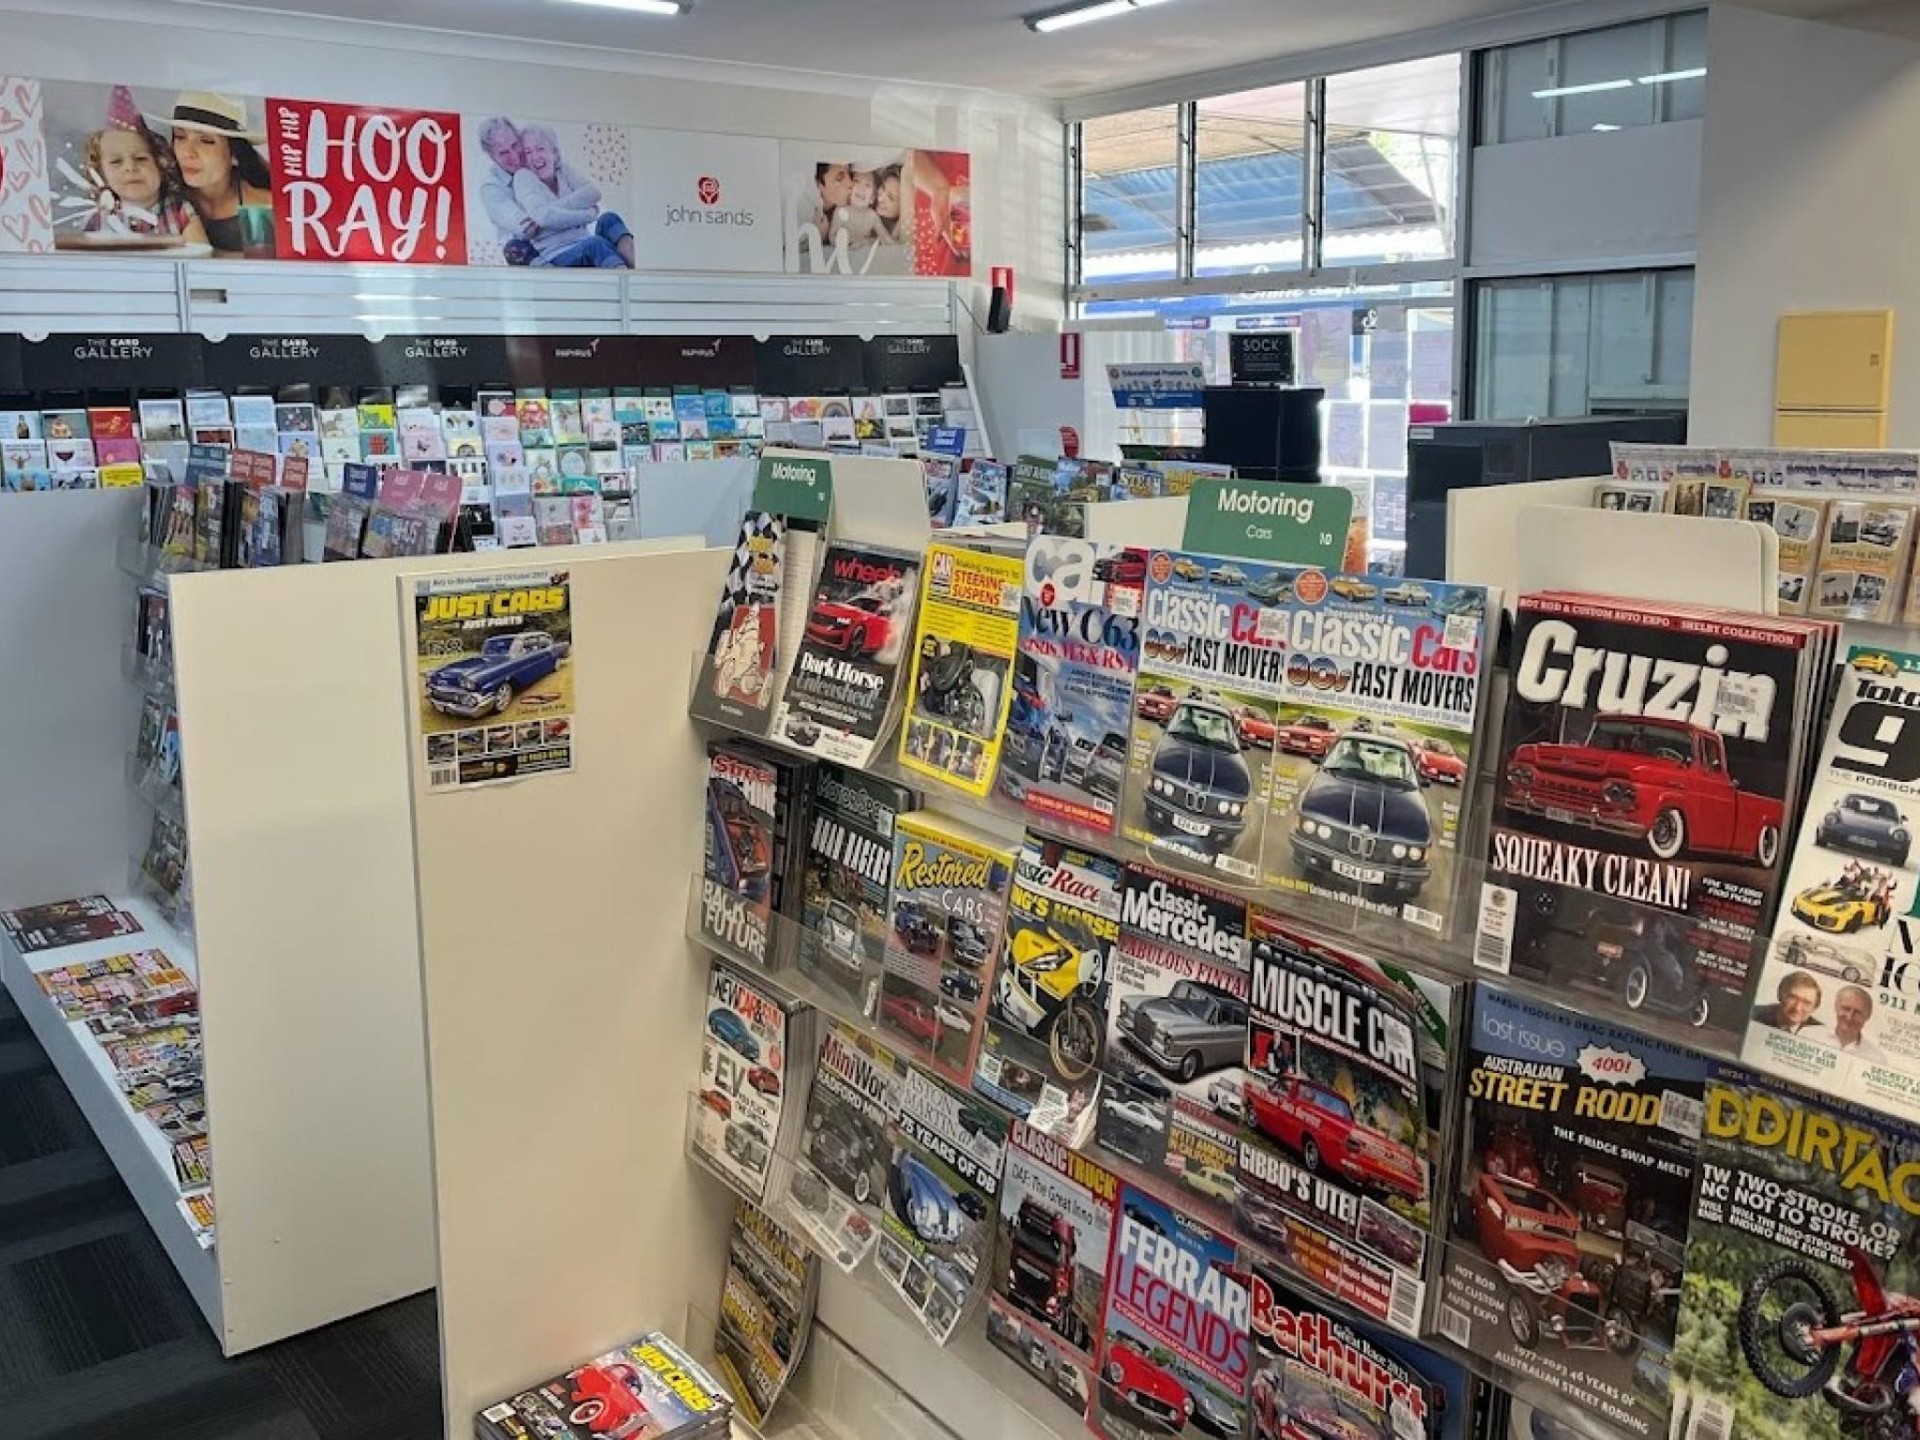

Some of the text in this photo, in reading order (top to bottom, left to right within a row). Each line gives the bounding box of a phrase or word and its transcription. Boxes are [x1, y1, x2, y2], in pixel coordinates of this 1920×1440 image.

[282, 106, 304, 177] HIP HIP
[305, 109, 453, 186] HOO
[283, 181, 453, 261] RAY!
[664, 205, 755, 227] john sands
[74, 346, 153, 359] GALLERY
[110, 338, 140, 347] CARD
[249, 346, 319, 359] GALLERY
[405, 346, 468, 358] GALLERY
[783, 345, 832, 357] GALLERY
[1242, 338, 1281, 352] SOCK
[771, 462, 817, 487] Motoring
[1217, 489, 1315, 524] Motoring
[1245, 524, 1274, 540] Cars
[1319, 532, 1333, 546] 10
[424, 586, 566, 622] JUST CARS
[1148, 588, 1232, 641] Classic
[1518, 598, 1540, 610] HOT
[1572, 604, 1613, 619] CUSTOM
[1614, 607, 1641, 623] AUTO
[1642, 612, 1671, 628] EXPO
[1681, 620, 1722, 636] SHELBY
[1723, 624, 1795, 646] COLLECTION
[1081, 607, 1141, 651] C63
[1291, 608, 1412, 665] Classic
[801, 651, 886, 691] Dark Horse
[1186, 635, 1221, 672] FAST
[1351, 660, 1399, 700] FAST
[1401, 668, 1476, 714] MOVERS
[1517, 619, 1778, 743] Cruzin
[896, 842, 994, 891] Restored
[1492, 832, 1692, 910] SQUEAKY CLEAN!
[704, 876, 747, 915] BACK
[942, 888, 984, 923] CARS
[1149, 879, 1208, 925] Classic
[704, 903, 767, 965] FUTURE
[1122, 886, 1243, 964] Mercedes
[1251, 956, 1363, 1050] MUSCLE
[1879, 992, 1907, 1012] 911
[1481, 1010, 1567, 1059] last issue
[715, 1051, 749, 1098] EV
[1482, 1054, 1565, 1083] AUSTRALIAN
[1591, 1055, 1633, 1075] 400!
[1468, 1067, 1570, 1113] STREET
[900, 1113, 998, 1195] 75 YEARS OF DB
[1012, 1119, 1117, 1201] CLASSIC TRUCK
[1551, 1124, 1692, 1180] THE FRIDGE SWAP MEET
[1239, 1142, 1359, 1226] GIBBO'S UTE!
[1734, 1185, 1898, 1262] NOT TO STROKE?
[1737, 1169, 1902, 1247] TWO-STROKE, OR
[1727, 1214, 1856, 1271] ENDURO BIKE EVER DIE?
[1757, 1212, 1776, 1232] THE
[1776, 1219, 1847, 1259] TWO-STROKE
[1454, 1263, 1498, 1293] HOT ROD
[1463, 1282, 1506, 1313] CUSTOM
[1113, 1253, 1250, 1380] LEGENDS
[1446, 1290, 1500, 1327] AUTO EXPO
[1251, 1273, 1428, 1421] Bathurst
[630, 1344, 717, 1413] JUST CARS
[1494, 1350, 1650, 1437] AUSTRALIAN STREET RODDING
[1569, 1368, 1585, 1383] 46
[1584, 1372, 1623, 1402] YEARS
[1620, 1393, 1637, 1409] OF
